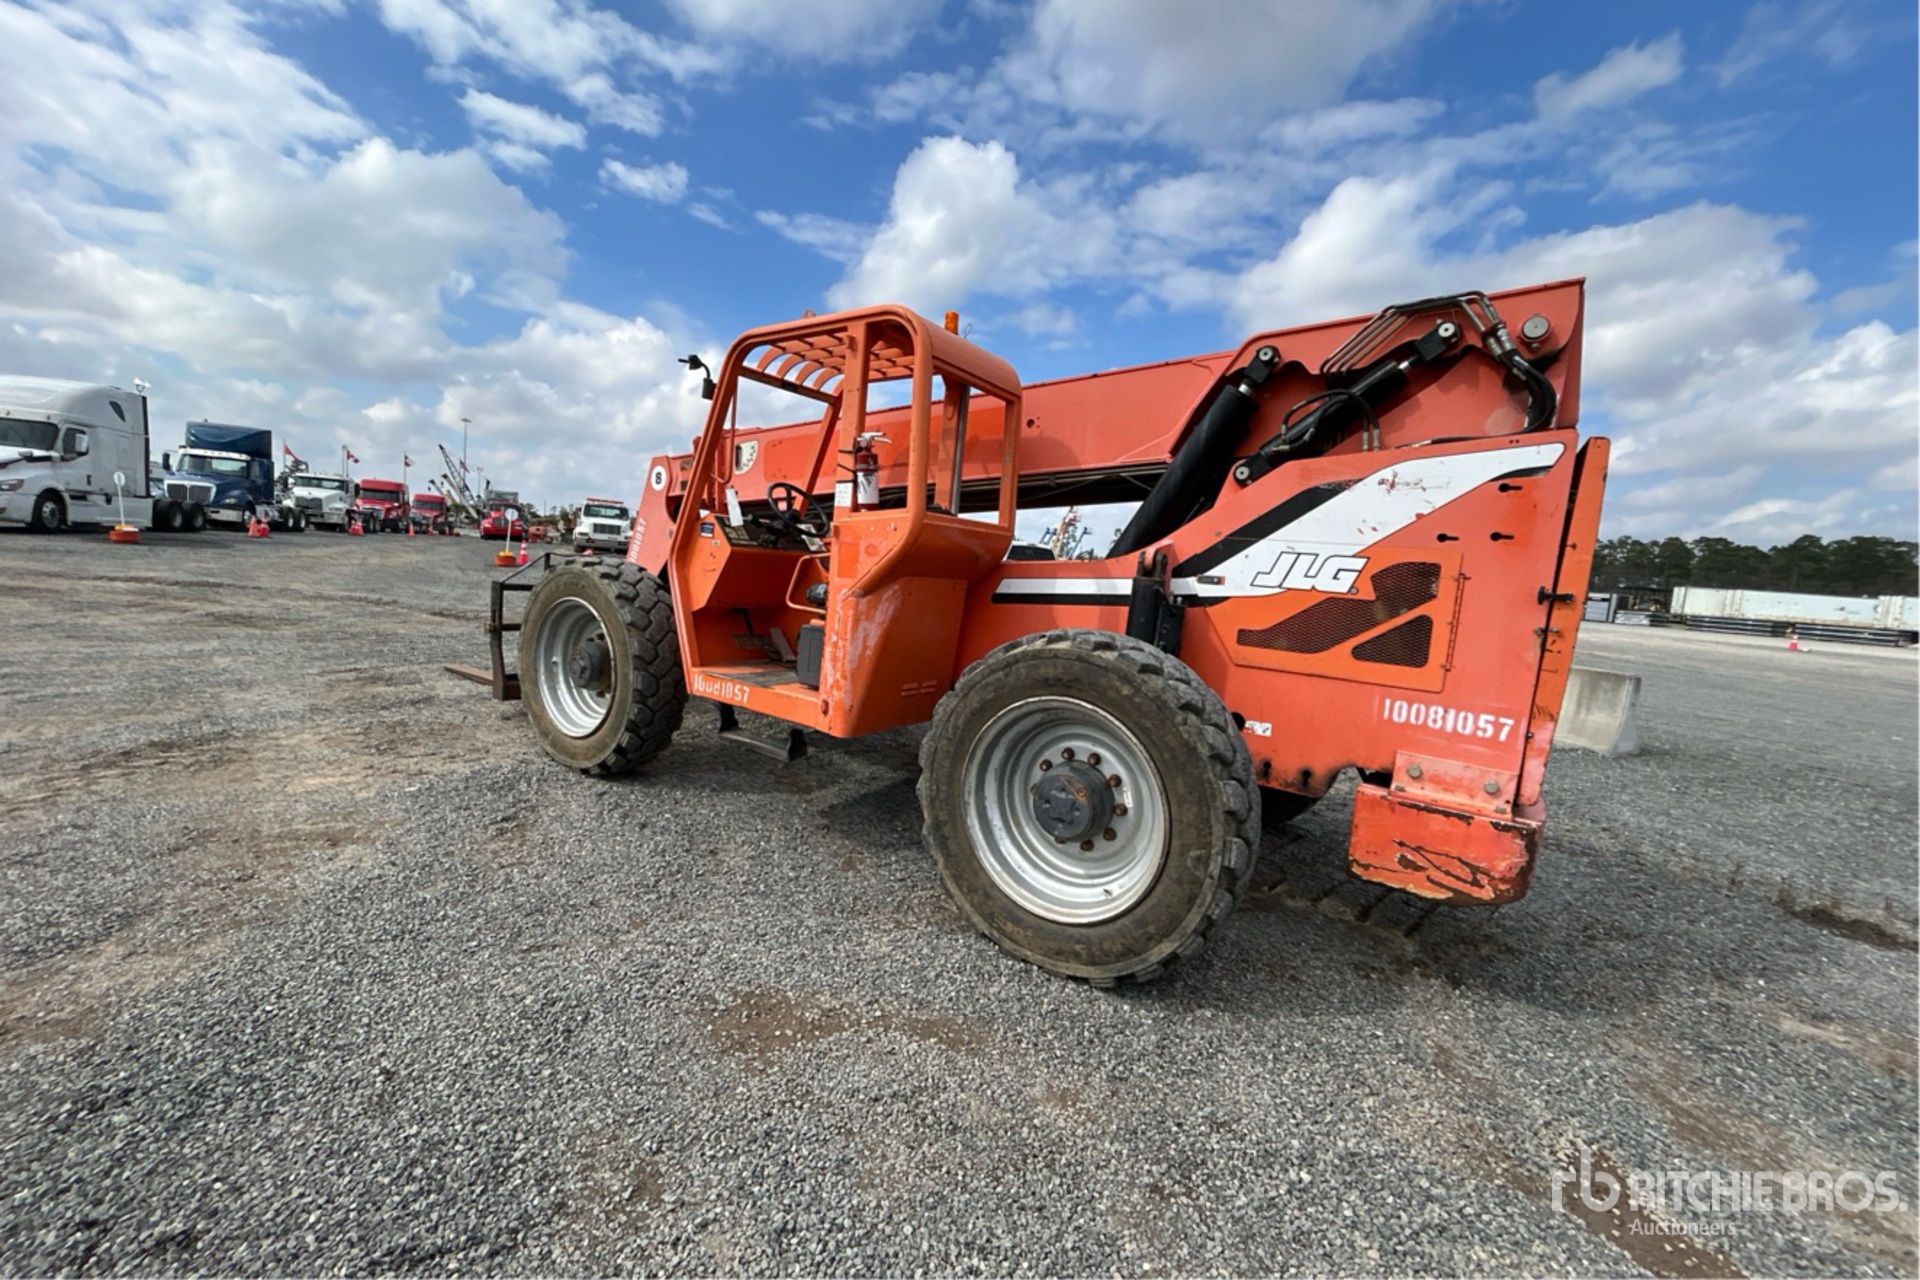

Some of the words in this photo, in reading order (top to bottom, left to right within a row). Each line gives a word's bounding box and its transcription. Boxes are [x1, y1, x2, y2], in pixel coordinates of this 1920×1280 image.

[655, 471, 662, 485] 8
[1250, 550, 1370, 594] JLG
[1383, 697, 1515, 742] 10081057
